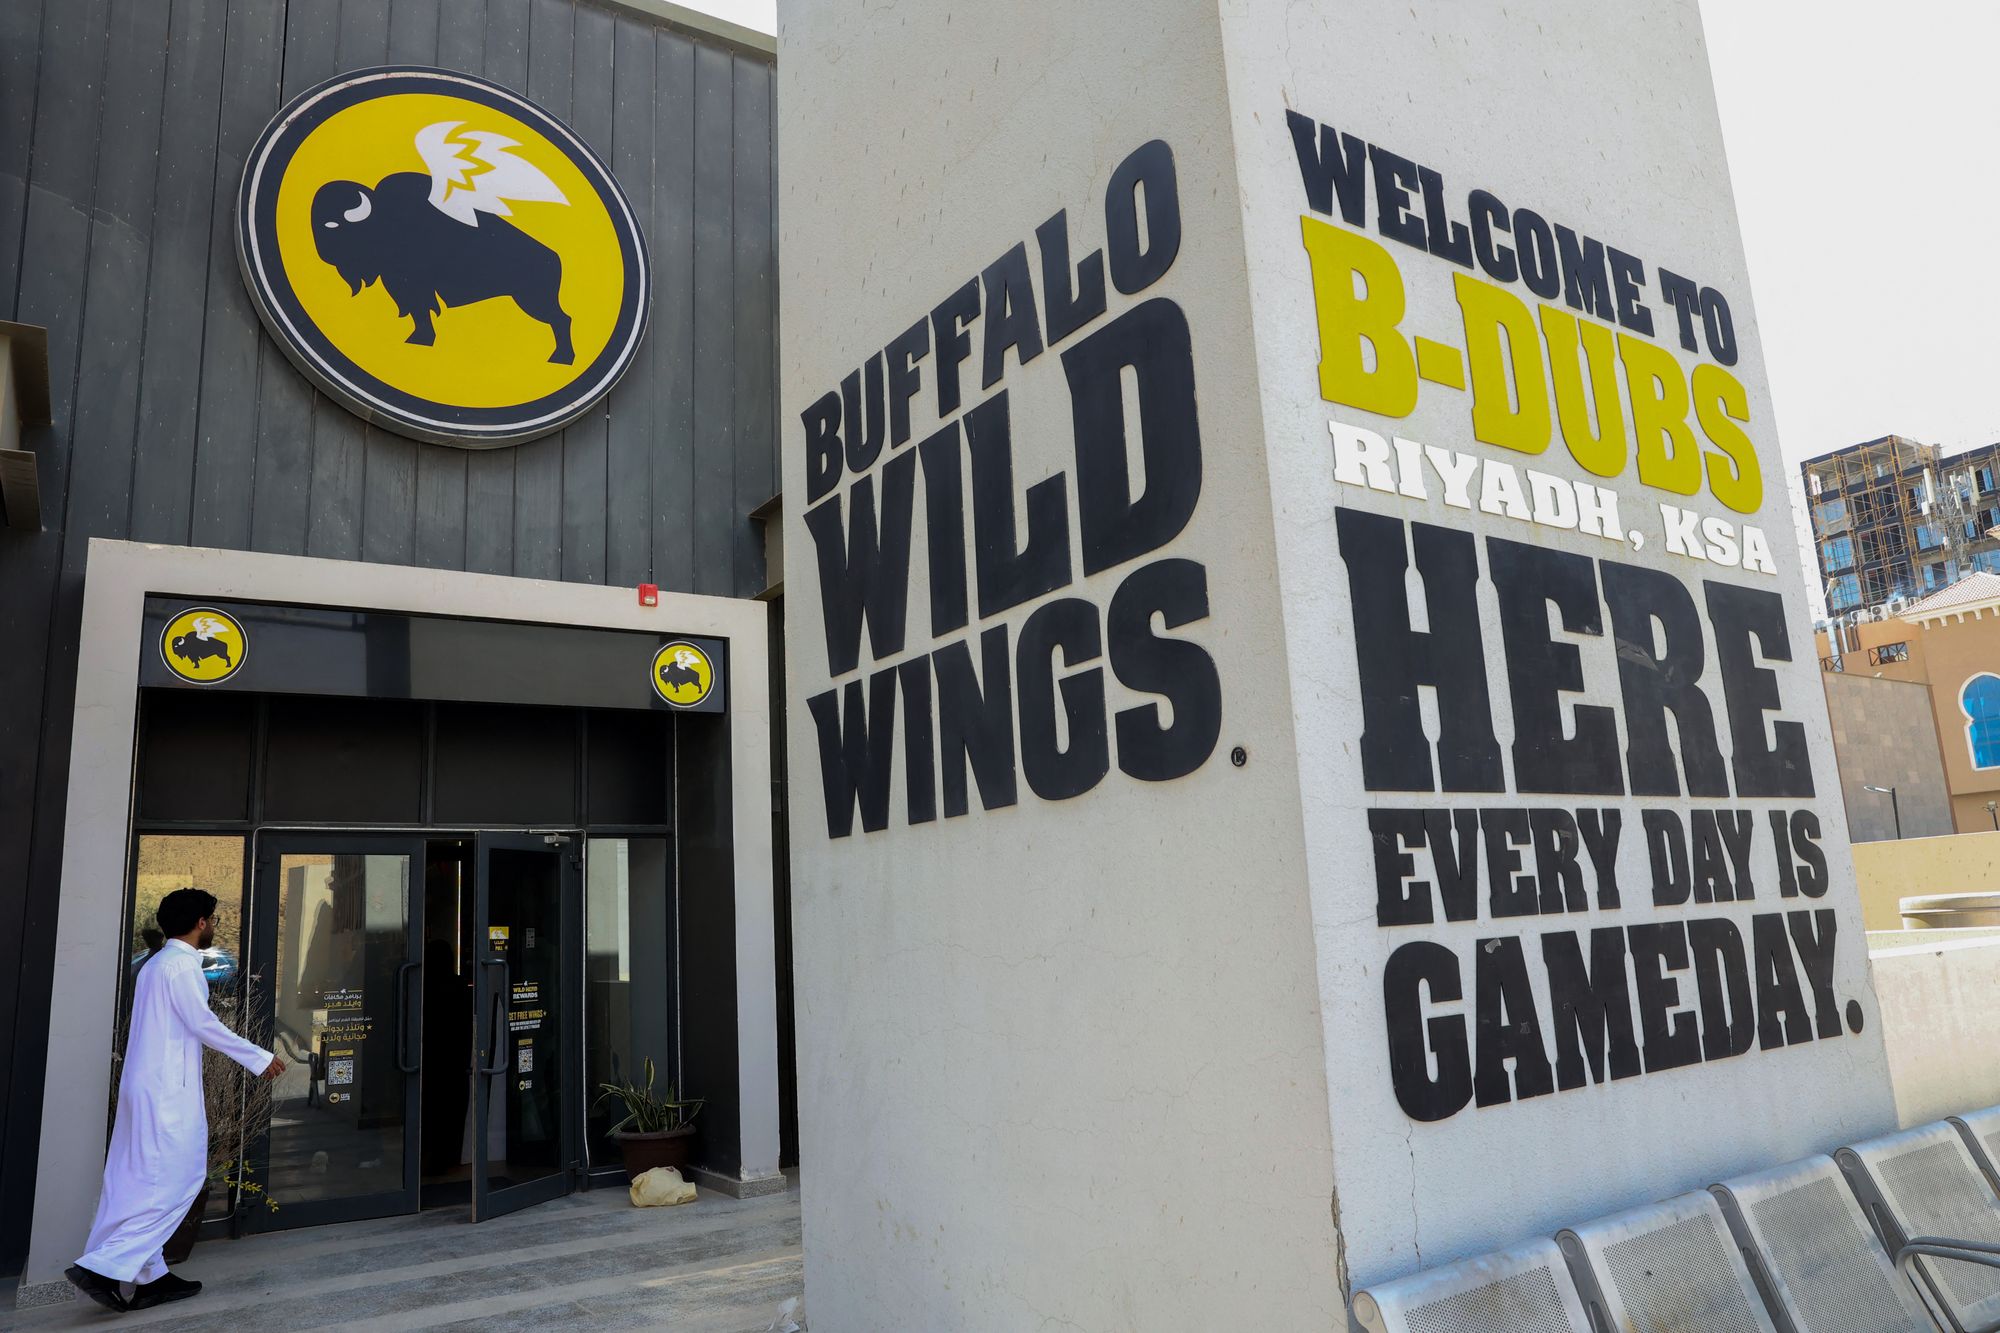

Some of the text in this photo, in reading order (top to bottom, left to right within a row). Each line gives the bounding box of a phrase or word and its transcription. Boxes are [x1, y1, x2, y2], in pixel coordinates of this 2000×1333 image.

[801, 139, 1181, 505] BUFFALO
[1285, 108, 1738, 366] WELCOME TO
[1300, 214, 1763, 514] B-DUBS
[803, 297, 1202, 678] WILD
[1328, 420, 1778, 575] RIYADH, KSA
[806, 558, 1222, 839] WINGS
[1335, 506, 1816, 798] HERE
[1367, 808, 1829, 927] EVERY DAY IS
[1384, 909, 1864, 1122] GAMEDAY.
